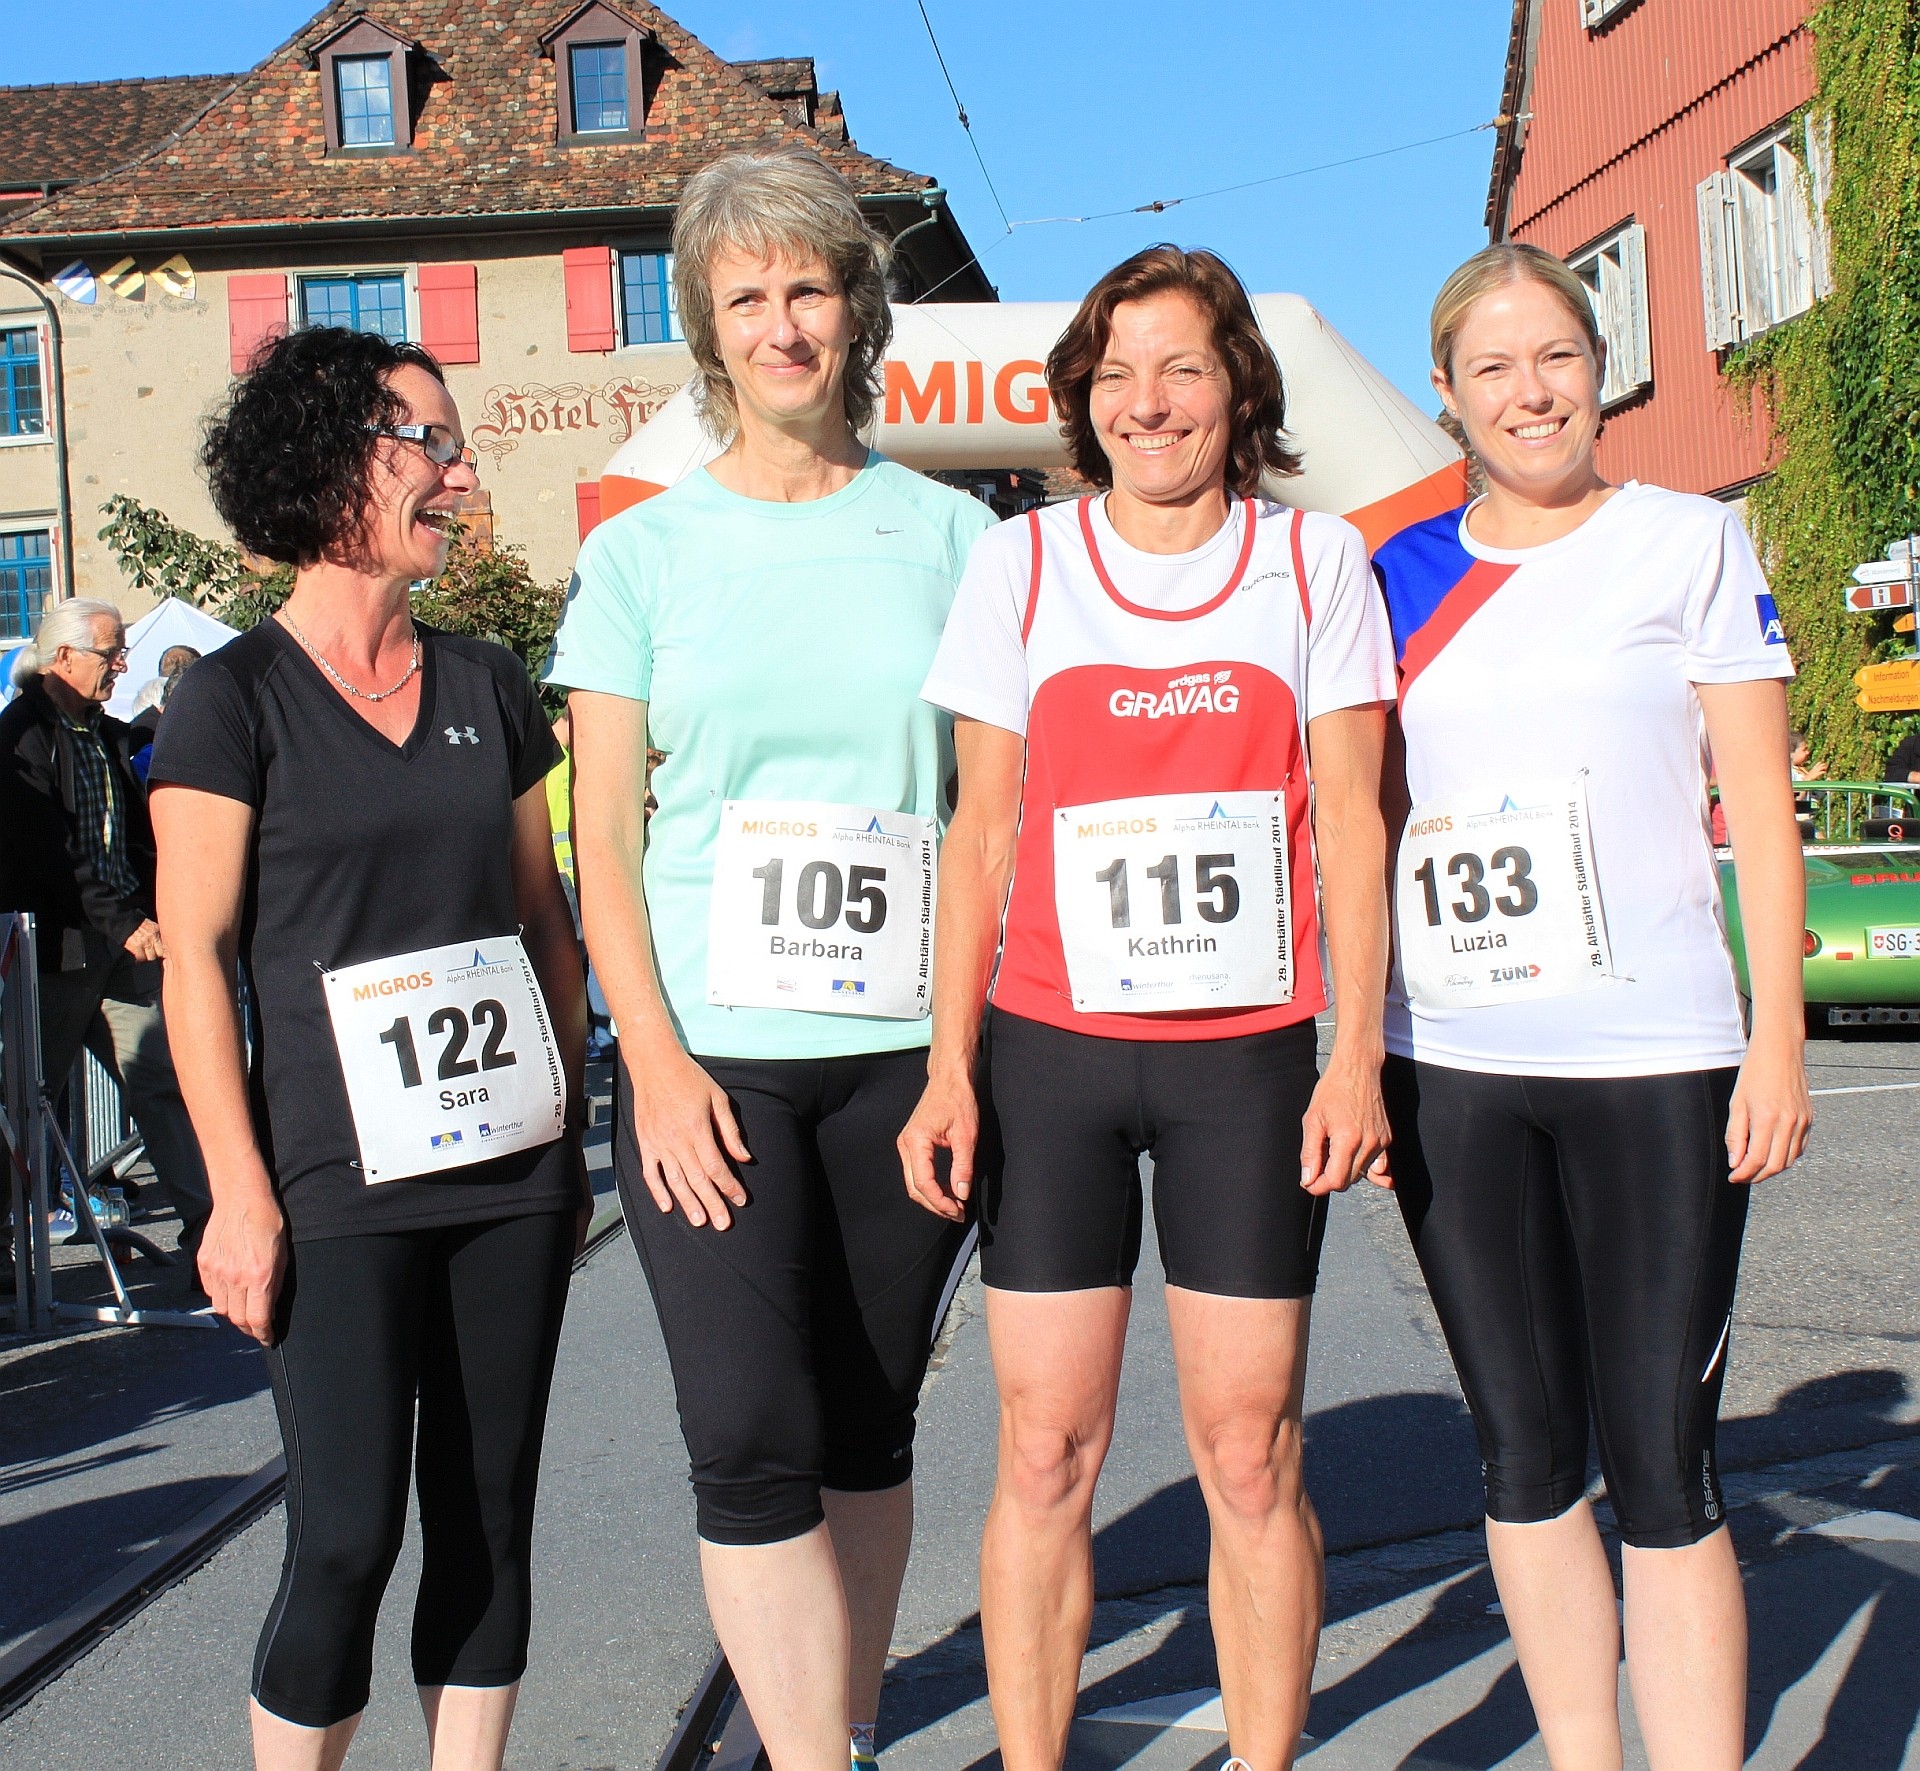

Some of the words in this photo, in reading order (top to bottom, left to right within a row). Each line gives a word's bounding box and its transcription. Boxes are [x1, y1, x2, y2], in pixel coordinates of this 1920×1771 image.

[883, 359, 1053, 425] MIG
[1168, 672, 1210, 689] erdgas
[1873, 670, 1909, 681] Information
[1109, 684, 1240, 719] GRAVAG
[1868, 693, 1919, 705] Nachmeldungen
[1173, 823, 1195, 834] Alpha
[1197, 820, 1241, 831] RHEINTAL
[1243, 819, 1260, 830] Bank
[1409, 816, 1453, 838] MIGROS
[1466, 819, 1487, 830] Alpha
[1490, 811, 1534, 825] RHEINTAL
[1568, 801, 1580, 829] 2014
[742, 820, 818, 837] MIGROS
[832, 832, 854, 843] Alpha
[856, 832, 895, 847] RHEINTAL
[896, 839, 911, 849] Bank
[1077, 817, 1158, 839] MIGROS
[1272, 816, 1281, 843] 2014
[922, 840, 930, 866] 2014
[1570, 832, 1589, 891] Städtlilauf
[1273, 844, 1285, 905] Städtlilauf
[1414, 845, 1538, 927] 133
[752, 858, 887, 933] 105
[921, 867, 931, 925] Städtlilauf
[1095, 853, 1240, 928] 115
[1582, 894, 1598, 947] Altstätter
[1128, 934, 1217, 957] Kathrin
[1277, 907, 1287, 961] Altstätter
[1450, 930, 1508, 953] Luzia
[770, 936, 863, 961] Barbara
[919, 927, 930, 979] Altstätter
[1591, 949, 1602, 967] 29.
[446, 973, 466, 984] Alpha
[466, 965, 500, 980] RHEINTAL
[500, 964, 514, 973] Bank
[521, 958, 534, 984] 2014
[1278, 963, 1287, 982] 29.
[353, 971, 433, 1002] MIGROS
[917, 981, 926, 999] 29.
[379, 998, 517, 1088] 122
[439, 1086, 490, 1110] Sara
[554, 1099, 562, 1118] 29.
